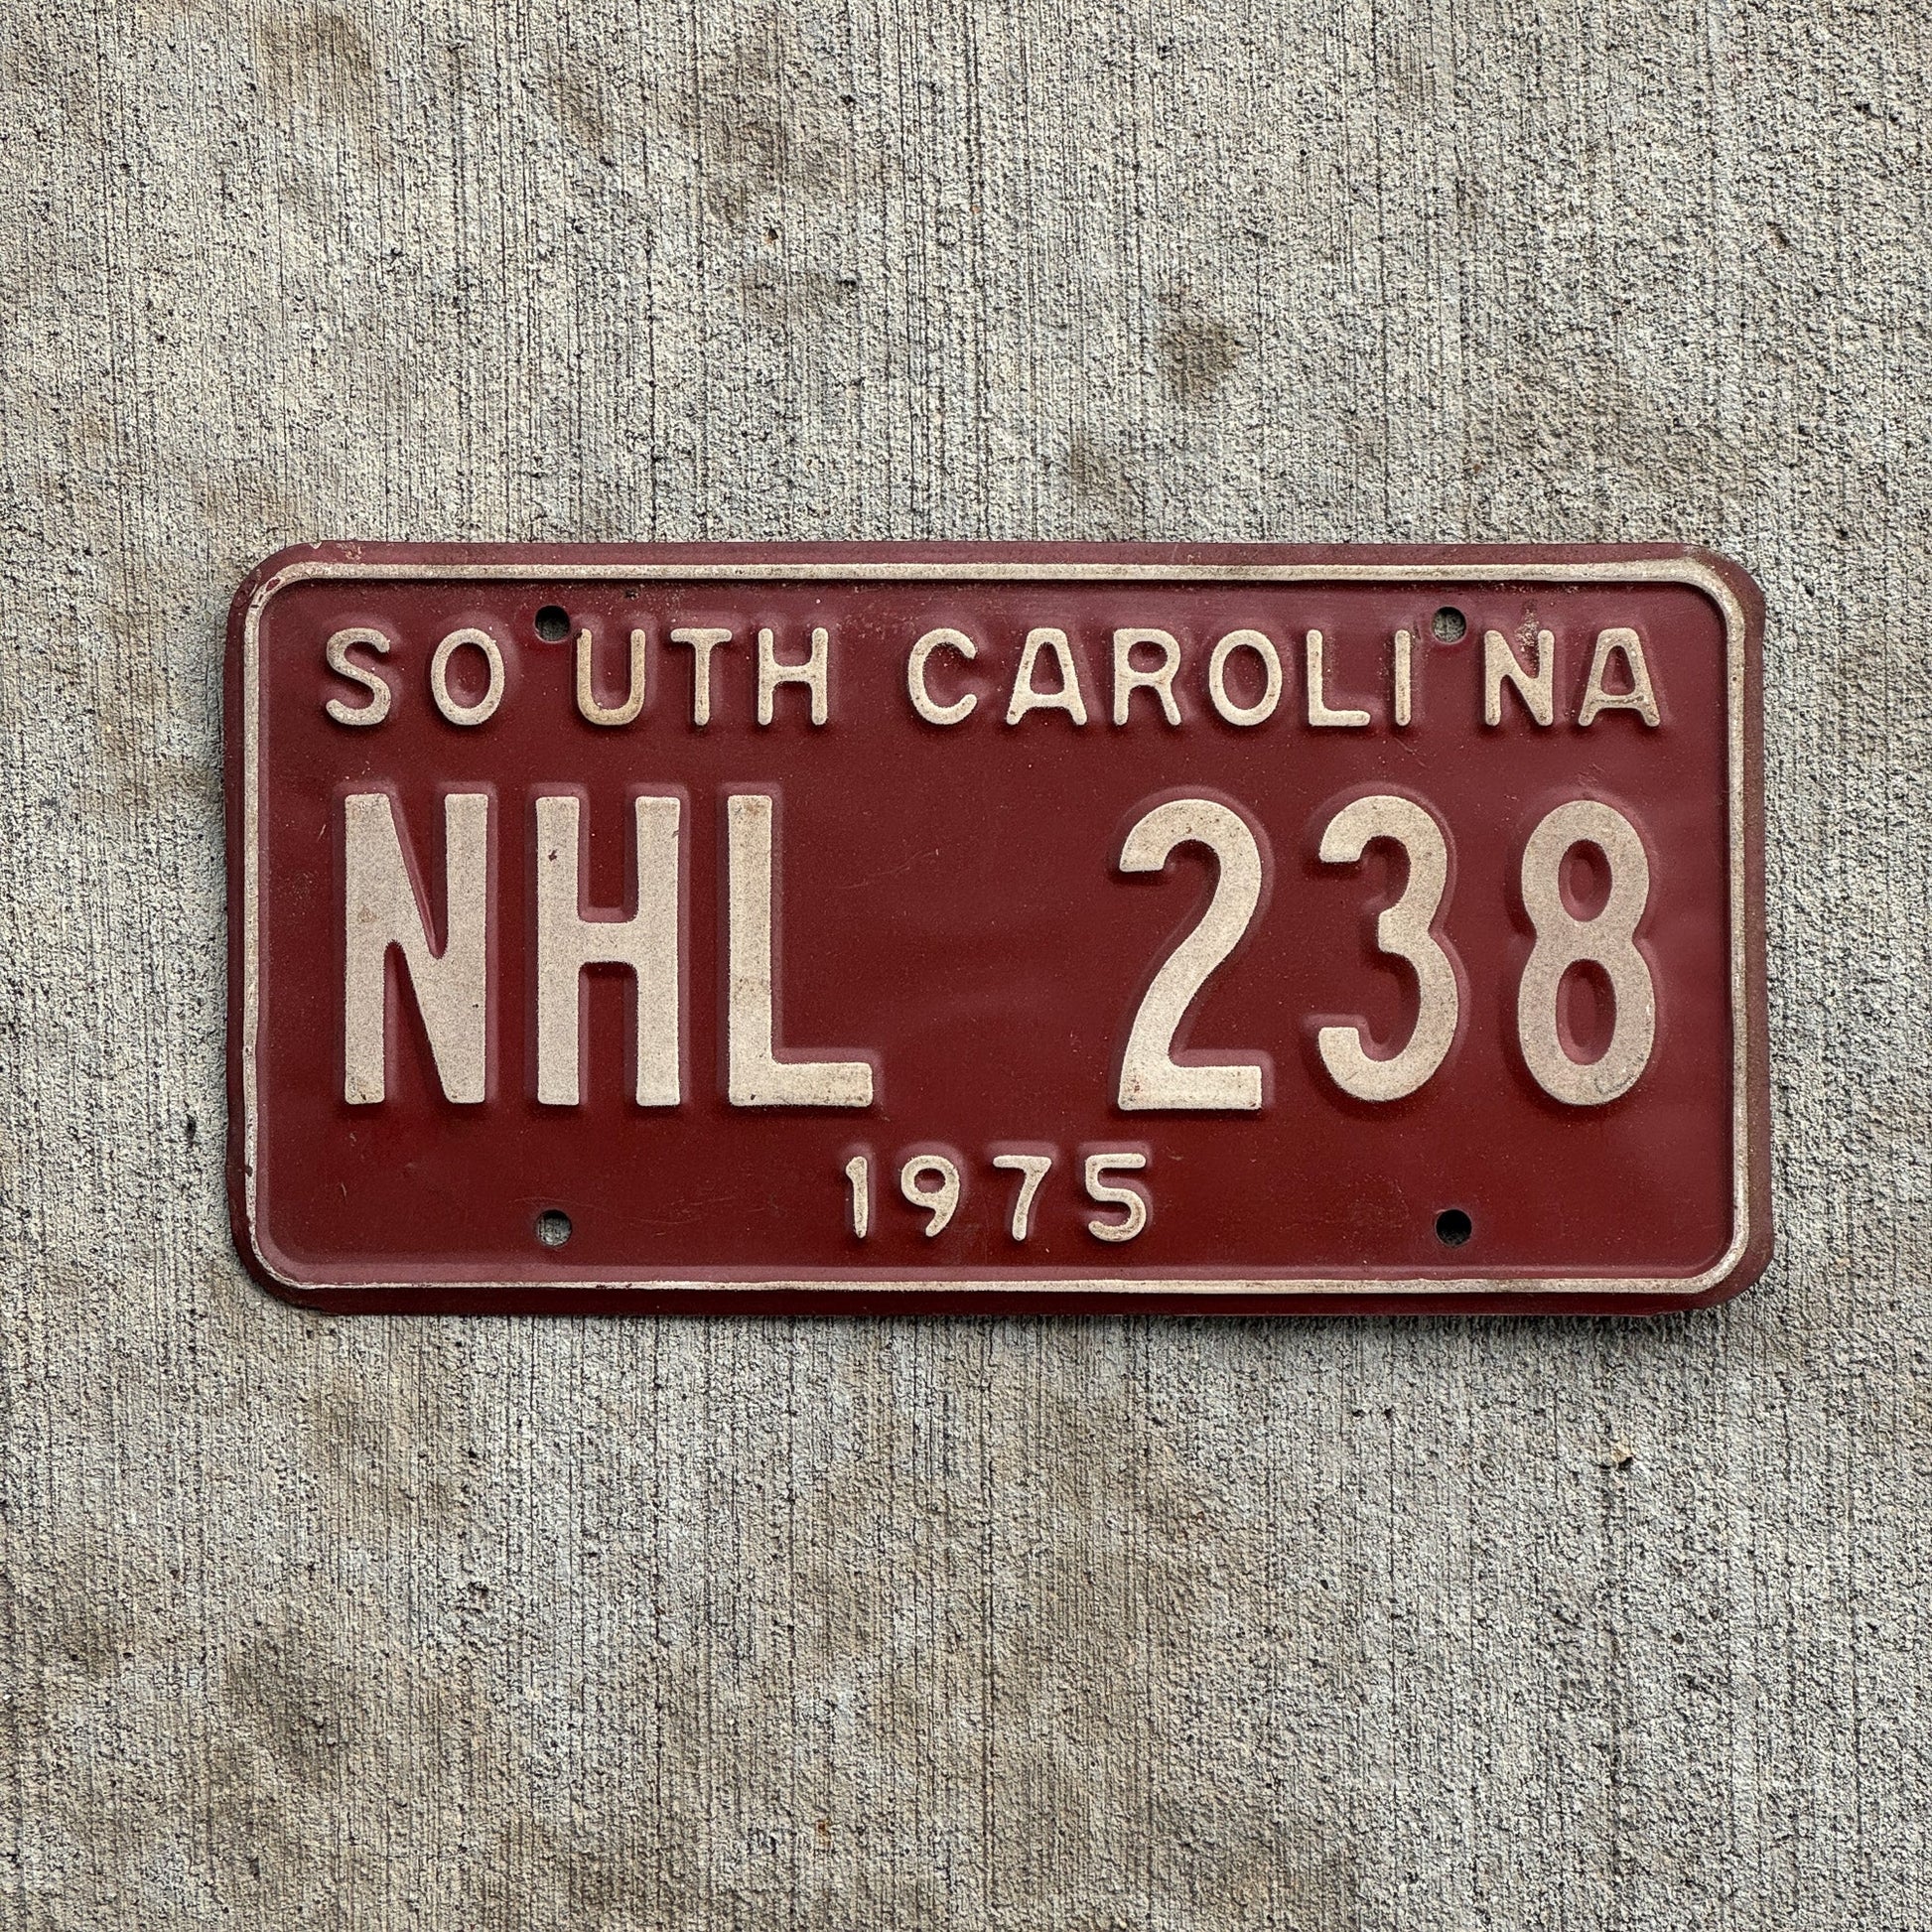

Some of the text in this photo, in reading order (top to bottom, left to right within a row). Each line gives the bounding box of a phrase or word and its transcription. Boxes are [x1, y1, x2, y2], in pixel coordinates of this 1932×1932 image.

[325, 626, 1662, 727] SOUTH CAROLINA
[344, 792, 1659, 1112] NHL 238
[844, 1152, 1149, 1243] 1975
